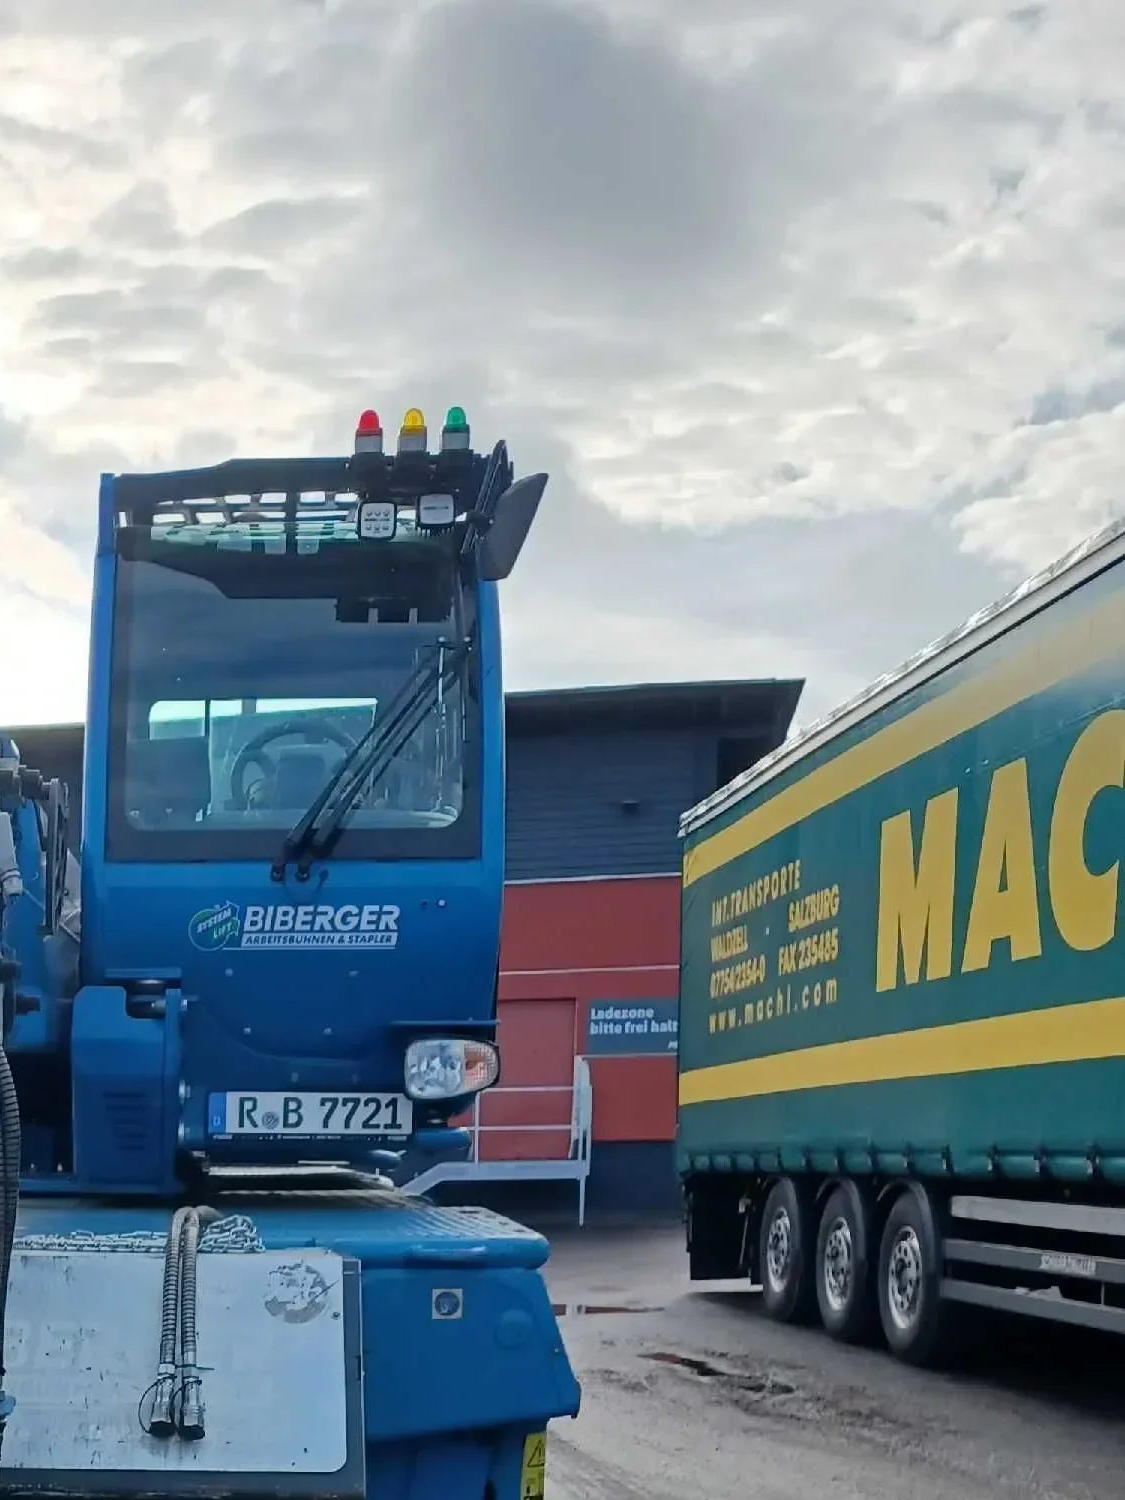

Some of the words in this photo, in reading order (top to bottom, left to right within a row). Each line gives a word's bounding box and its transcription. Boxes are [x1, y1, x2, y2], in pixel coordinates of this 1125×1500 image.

[243, 905, 401, 932] BIBERGER
[787, 883, 840, 933] SALZBURG
[348, 934, 393, 945] STAPLER
[590, 1006, 654, 1020] Ladezone
[590, 1021, 622, 1035] bitte
[624, 1020, 648, 1034] frei
[238, 1097, 258, 1128] R
[283, 1097, 303, 1128] B
[320, 1097, 402, 1130] 7721
